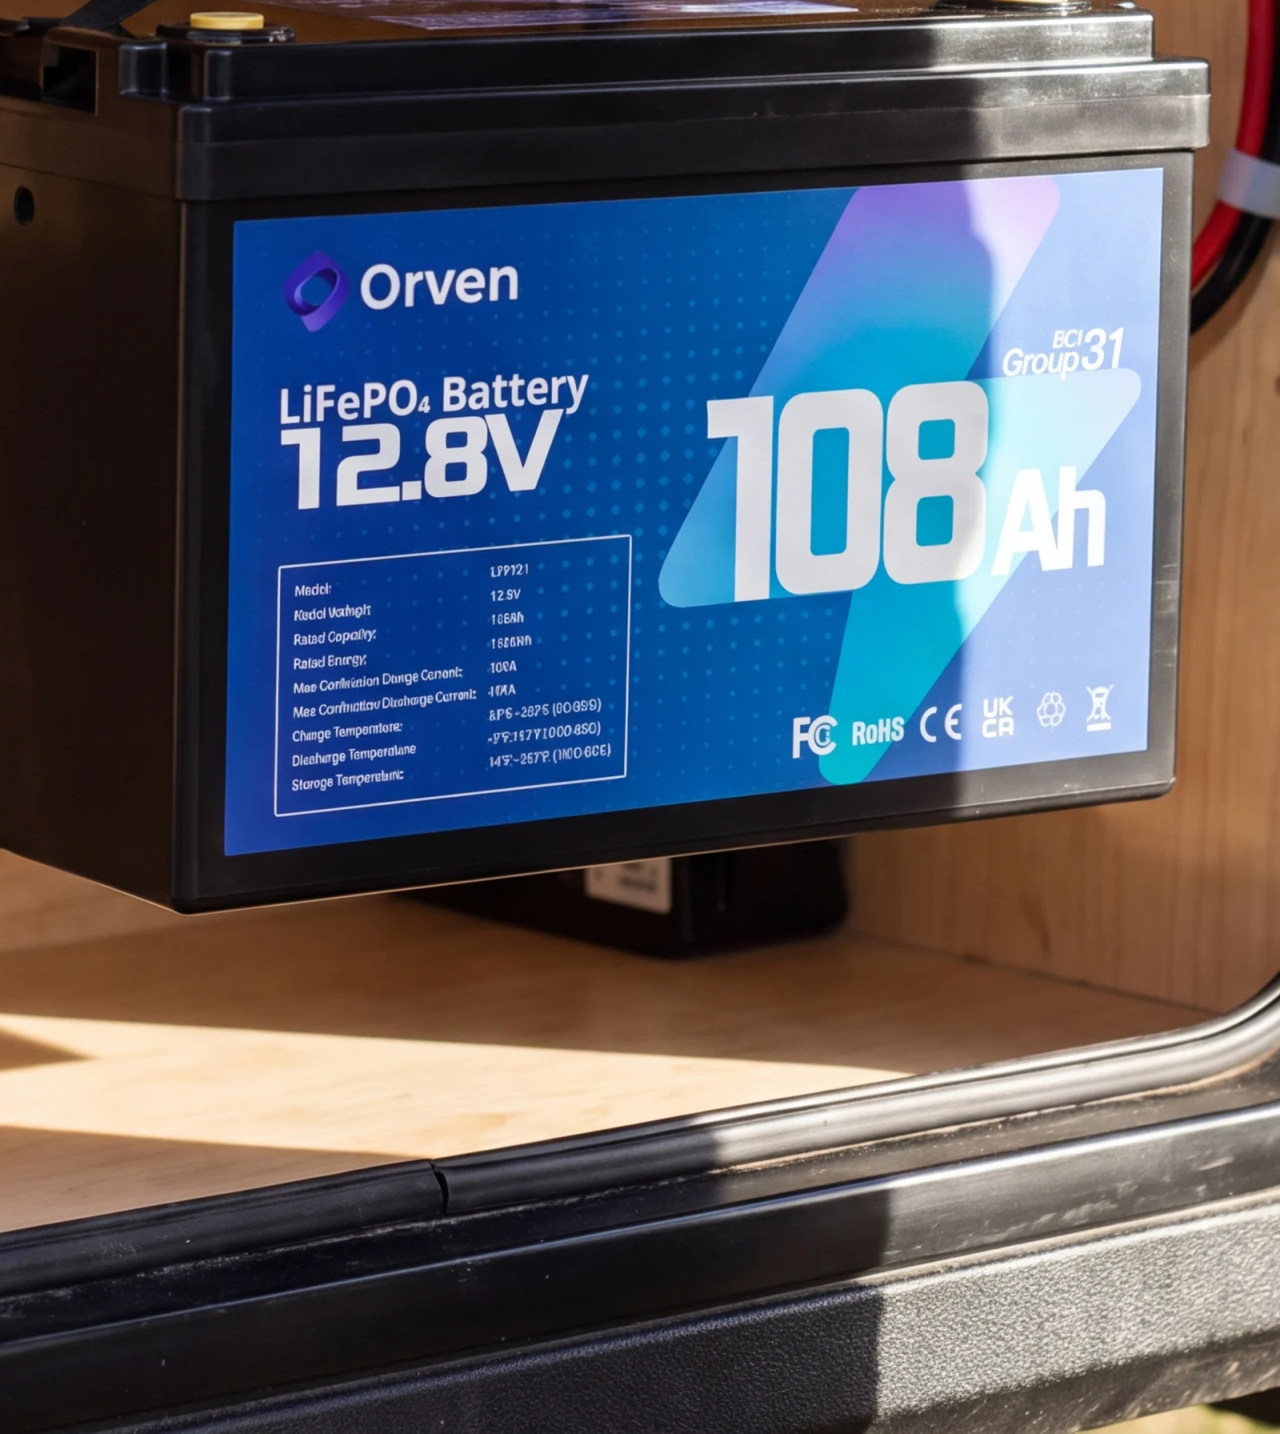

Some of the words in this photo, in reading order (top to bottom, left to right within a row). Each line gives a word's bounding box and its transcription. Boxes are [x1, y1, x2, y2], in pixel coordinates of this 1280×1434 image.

[360, 263, 519, 310] Orven
[1002, 347, 1080, 382] Group
[1081, 327, 1124, 371] 31
[1052, 329, 1083, 349] BCI
[442, 373, 589, 414] Battery
[280, 408, 564, 510] 12.8V
[706, 380, 989, 603] 108
[990, 465, 1107, 576] Ah
[852, 716, 905, 746] RoHS
[919, 703, 962, 743] CE
[982, 717, 1014, 738] CA
[983, 696, 1014, 717] UK
